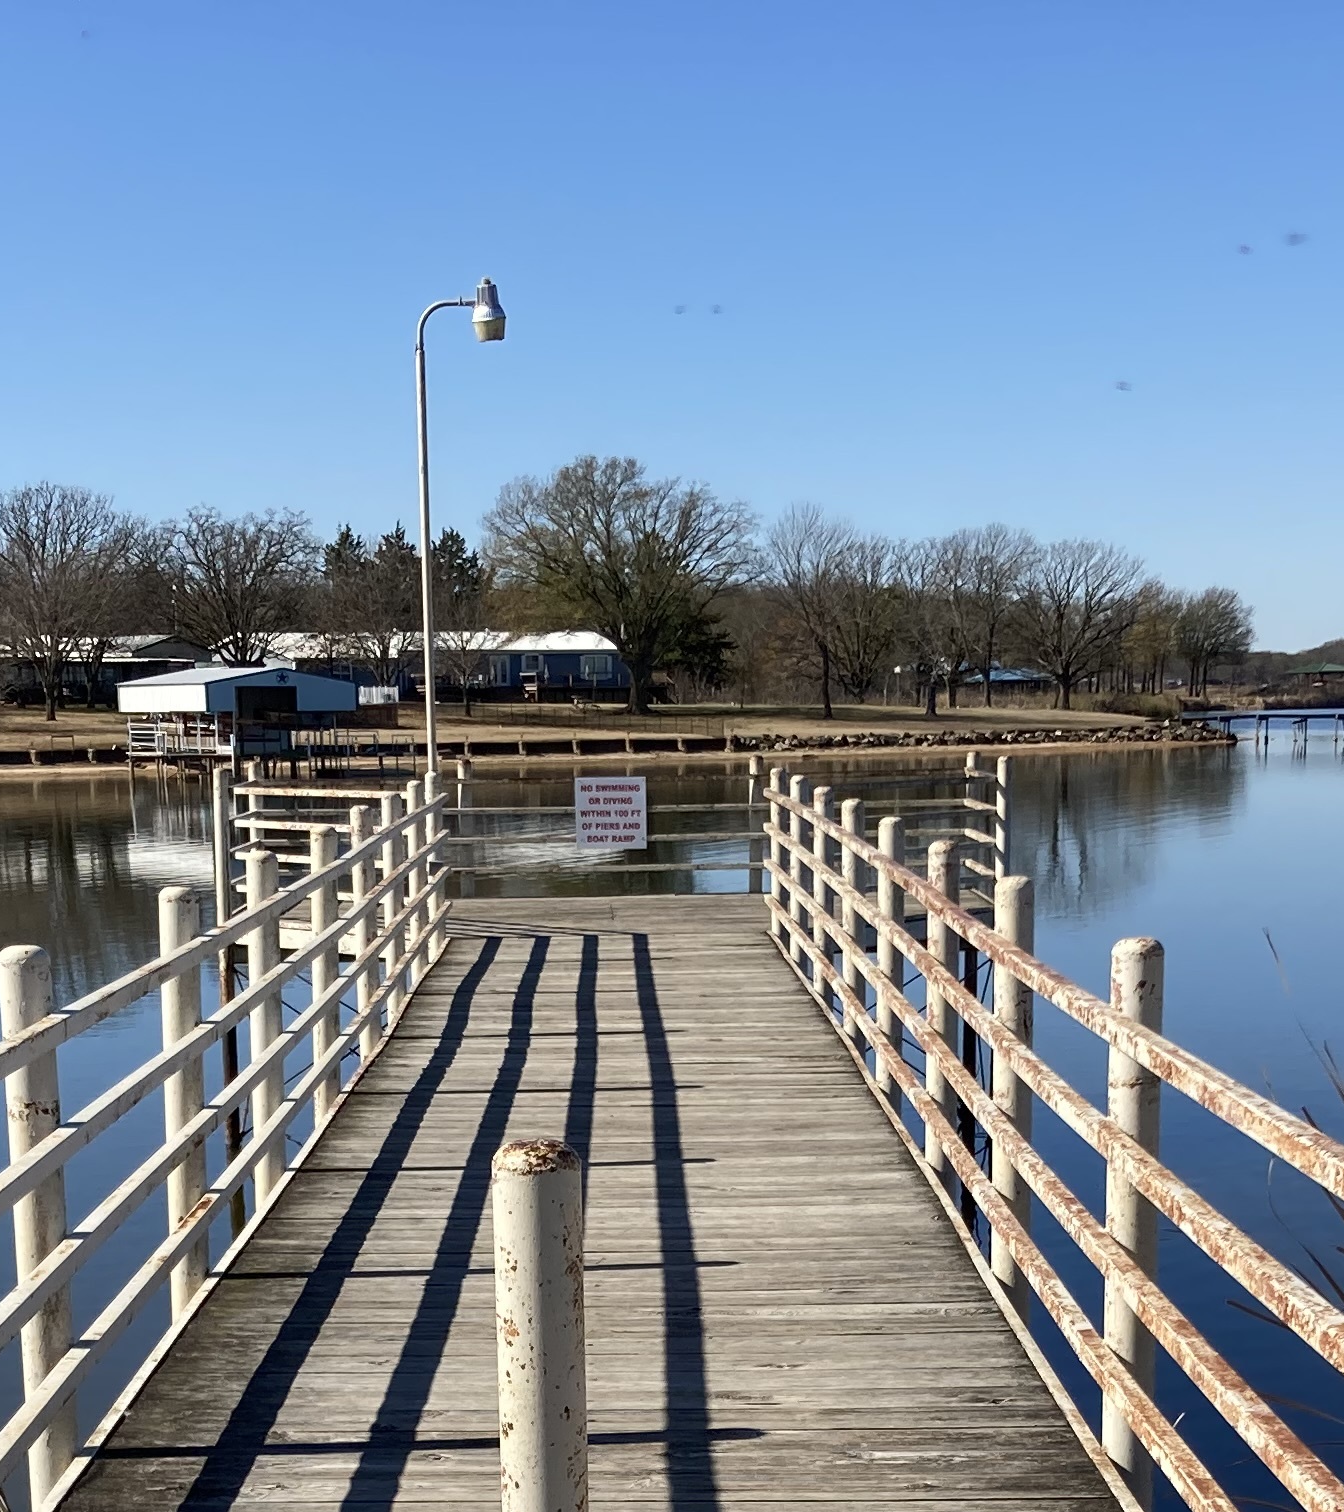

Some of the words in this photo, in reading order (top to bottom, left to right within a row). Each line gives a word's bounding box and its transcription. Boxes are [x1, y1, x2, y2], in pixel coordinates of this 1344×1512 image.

[596, 784, 640, 792] SWIMMING
[588, 797, 601, 805] OR
[603, 797, 633, 805] DIVING
[580, 810, 611, 818] WITHIN
[582, 822, 593, 830] OF
[596, 822, 621, 830] PIERS
[622, 822, 640, 830] AND
[587, 835, 608, 843] BOAT
[611, 835, 636, 843] RAMP
